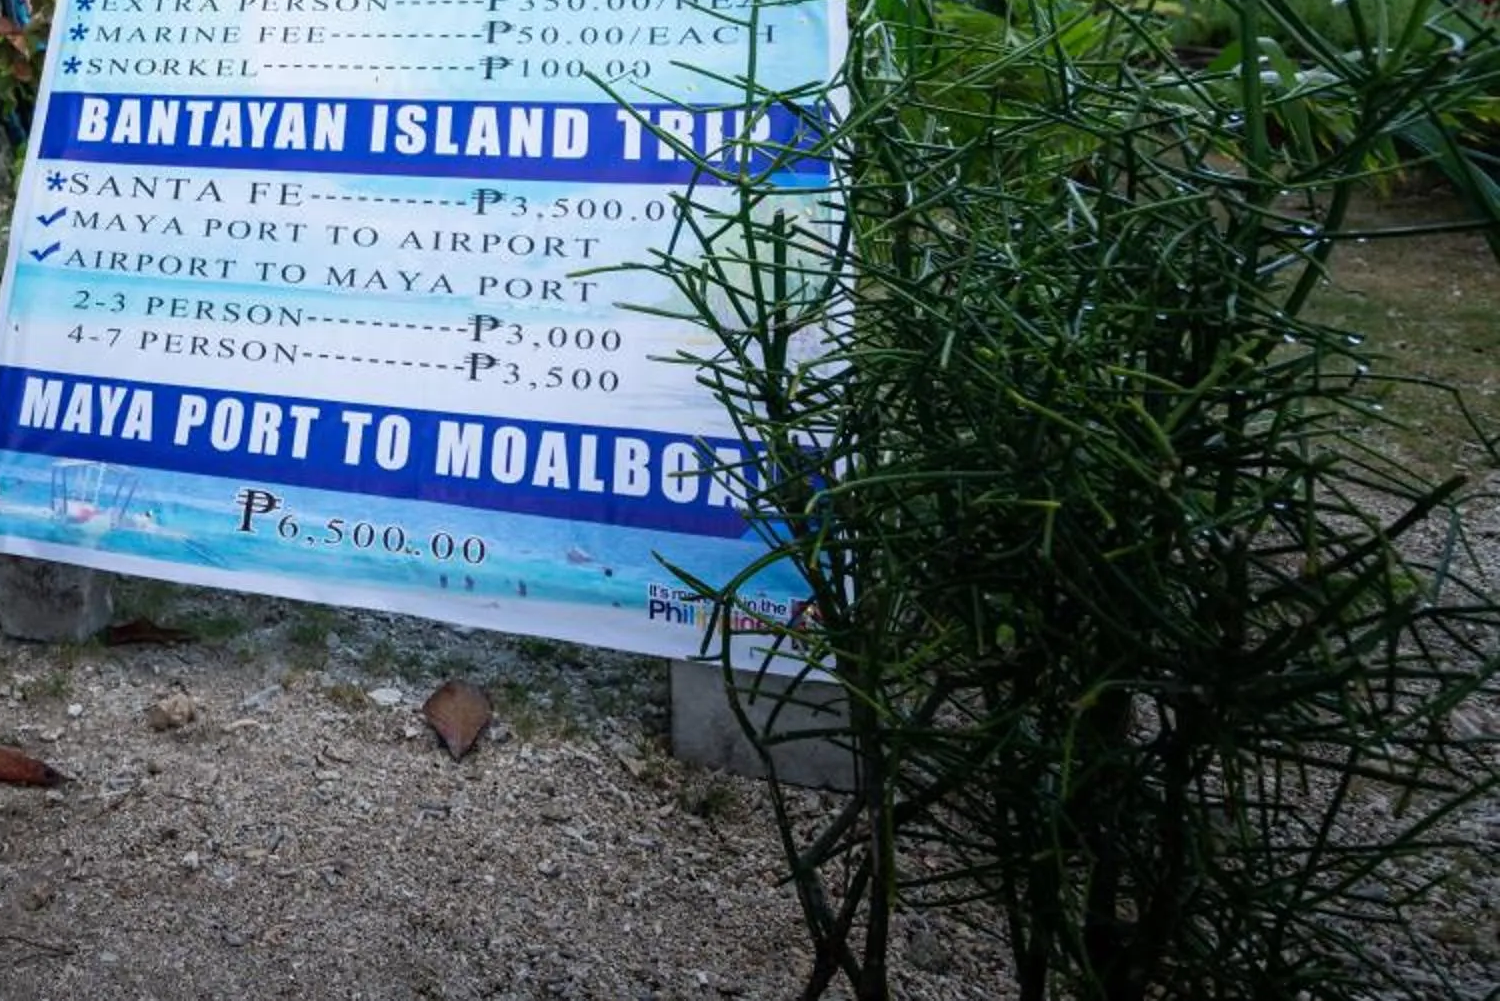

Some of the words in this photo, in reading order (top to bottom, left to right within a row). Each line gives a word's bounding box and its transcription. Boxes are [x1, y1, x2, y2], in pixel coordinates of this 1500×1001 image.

[77, 98, 348, 152] BANTAYAN
[369, 103, 590, 159] ISLAND
[616, 108, 772, 163] TRIP
[72, 209, 184, 237] MAYA
[203, 218, 308, 244] PORT
[326, 225, 379, 248] TO
[399, 230, 600, 259] AIRPORT
[64, 248, 237, 279] AIRPORT
[255, 261, 307, 284] TO
[325, 266, 454, 294] MAYA
[478, 275, 598, 303] PORT
[72, 289, 127, 313] 2-3
[67, 323, 122, 347] 4-7
[18, 376, 154, 443] MAYA
[173, 394, 321, 459] PORT
[341, 410, 411, 471] TO
